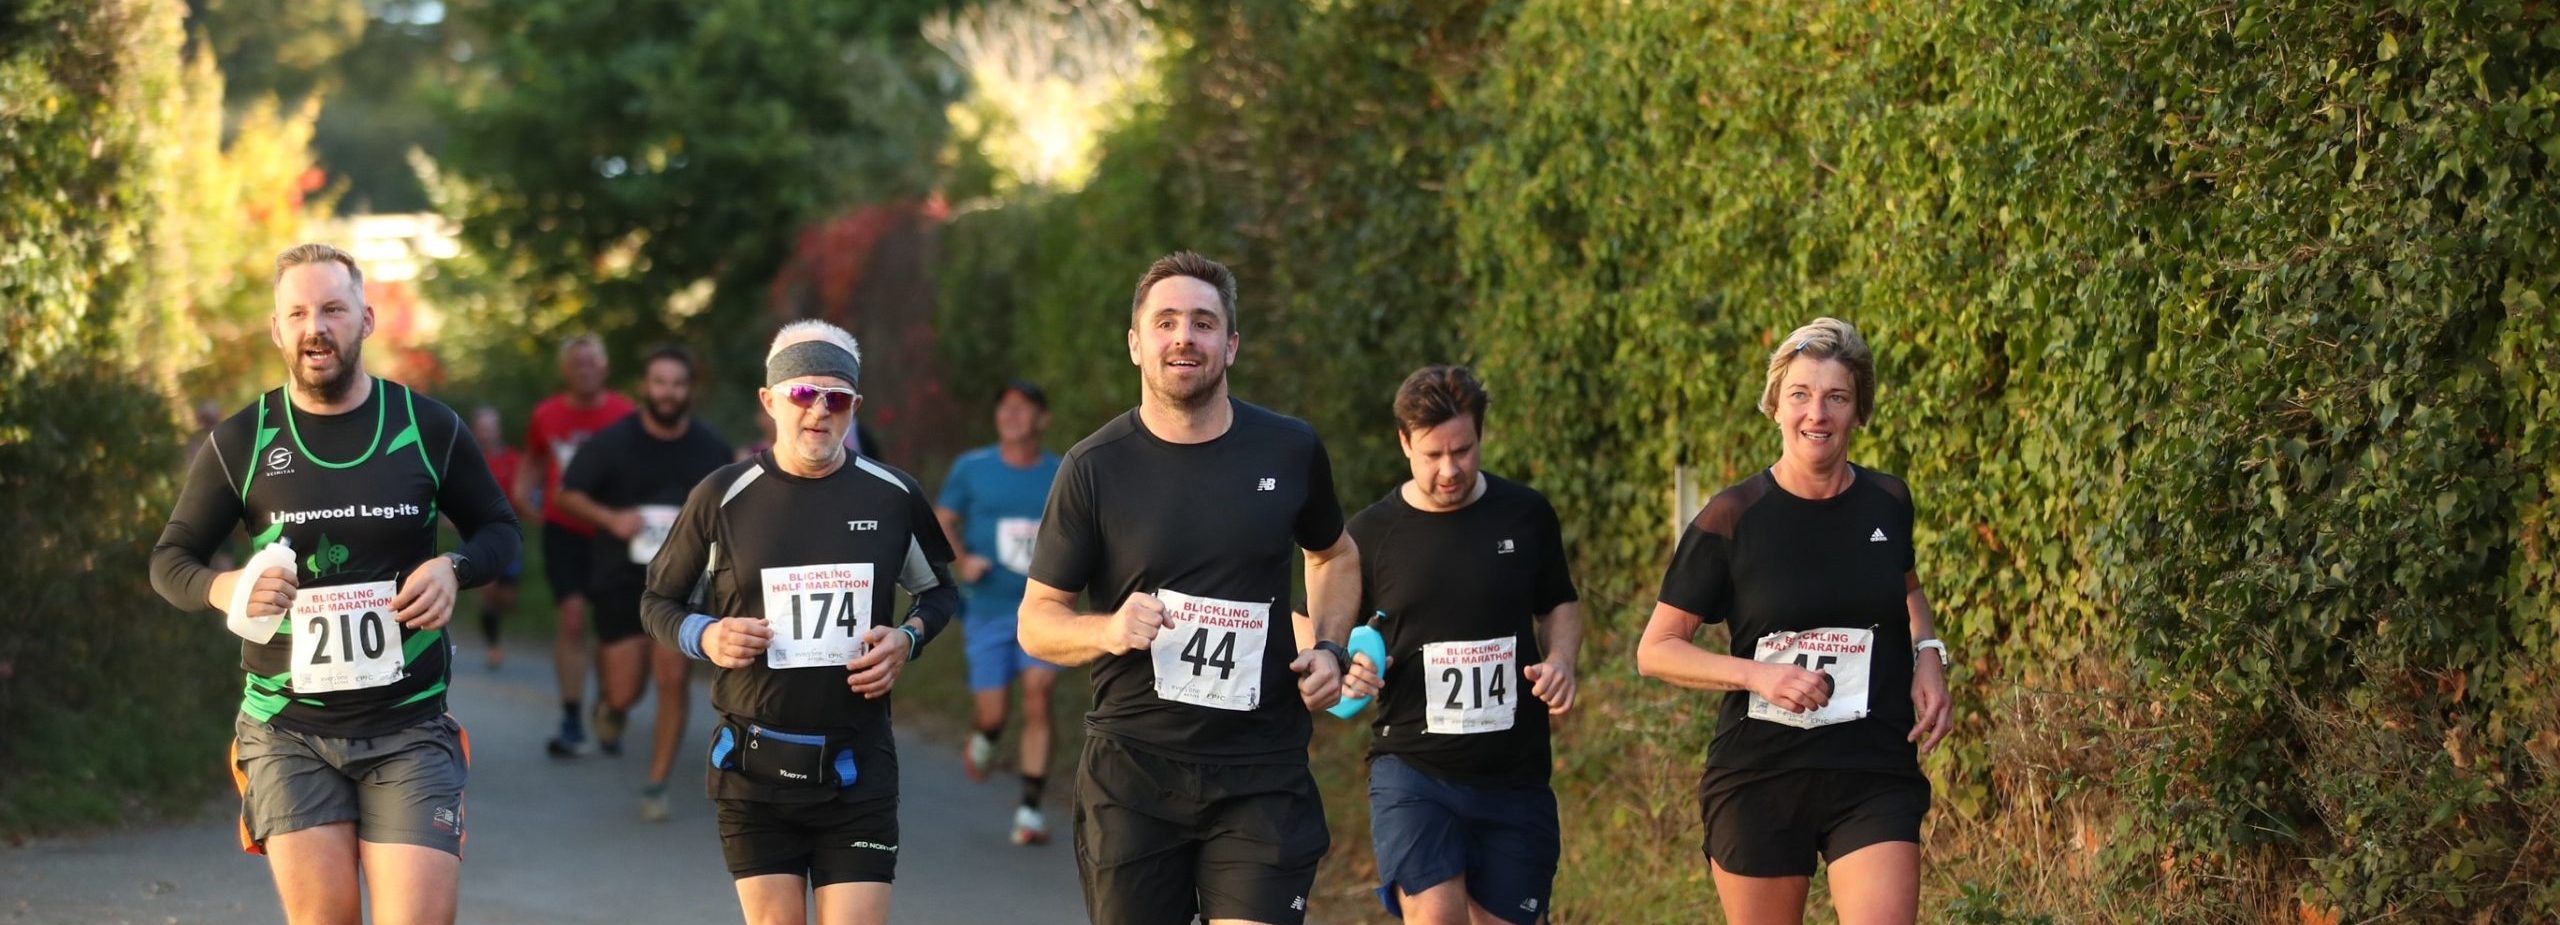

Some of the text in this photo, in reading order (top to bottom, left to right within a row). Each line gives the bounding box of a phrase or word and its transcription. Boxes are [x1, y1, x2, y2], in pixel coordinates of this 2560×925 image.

[270, 503, 419, 524] Lingwood Leg-its
[789, 570, 851, 581] BLICKLING
[772, 580, 869, 592] HALF MARATHON
[312, 589, 375, 603] BLICKLING
[297, 597, 393, 615] HALF MARATHON
[1183, 602, 1250, 618] BLICKLING
[791, 592, 857, 640] 174
[1199, 615, 1263, 629] MARATHON
[308, 611, 386, 665] 210
[1785, 632, 1849, 645] BICKLING
[1180, 627, 1237, 680] 44
[1446, 644, 1500, 656] BLICKLING
[1765, 640, 1866, 653] HA MARATHON
[1431, 650, 1514, 665] HALF MARATHON
[1442, 663, 1506, 709] 214
[1206, 692, 1226, 701] EPIC
